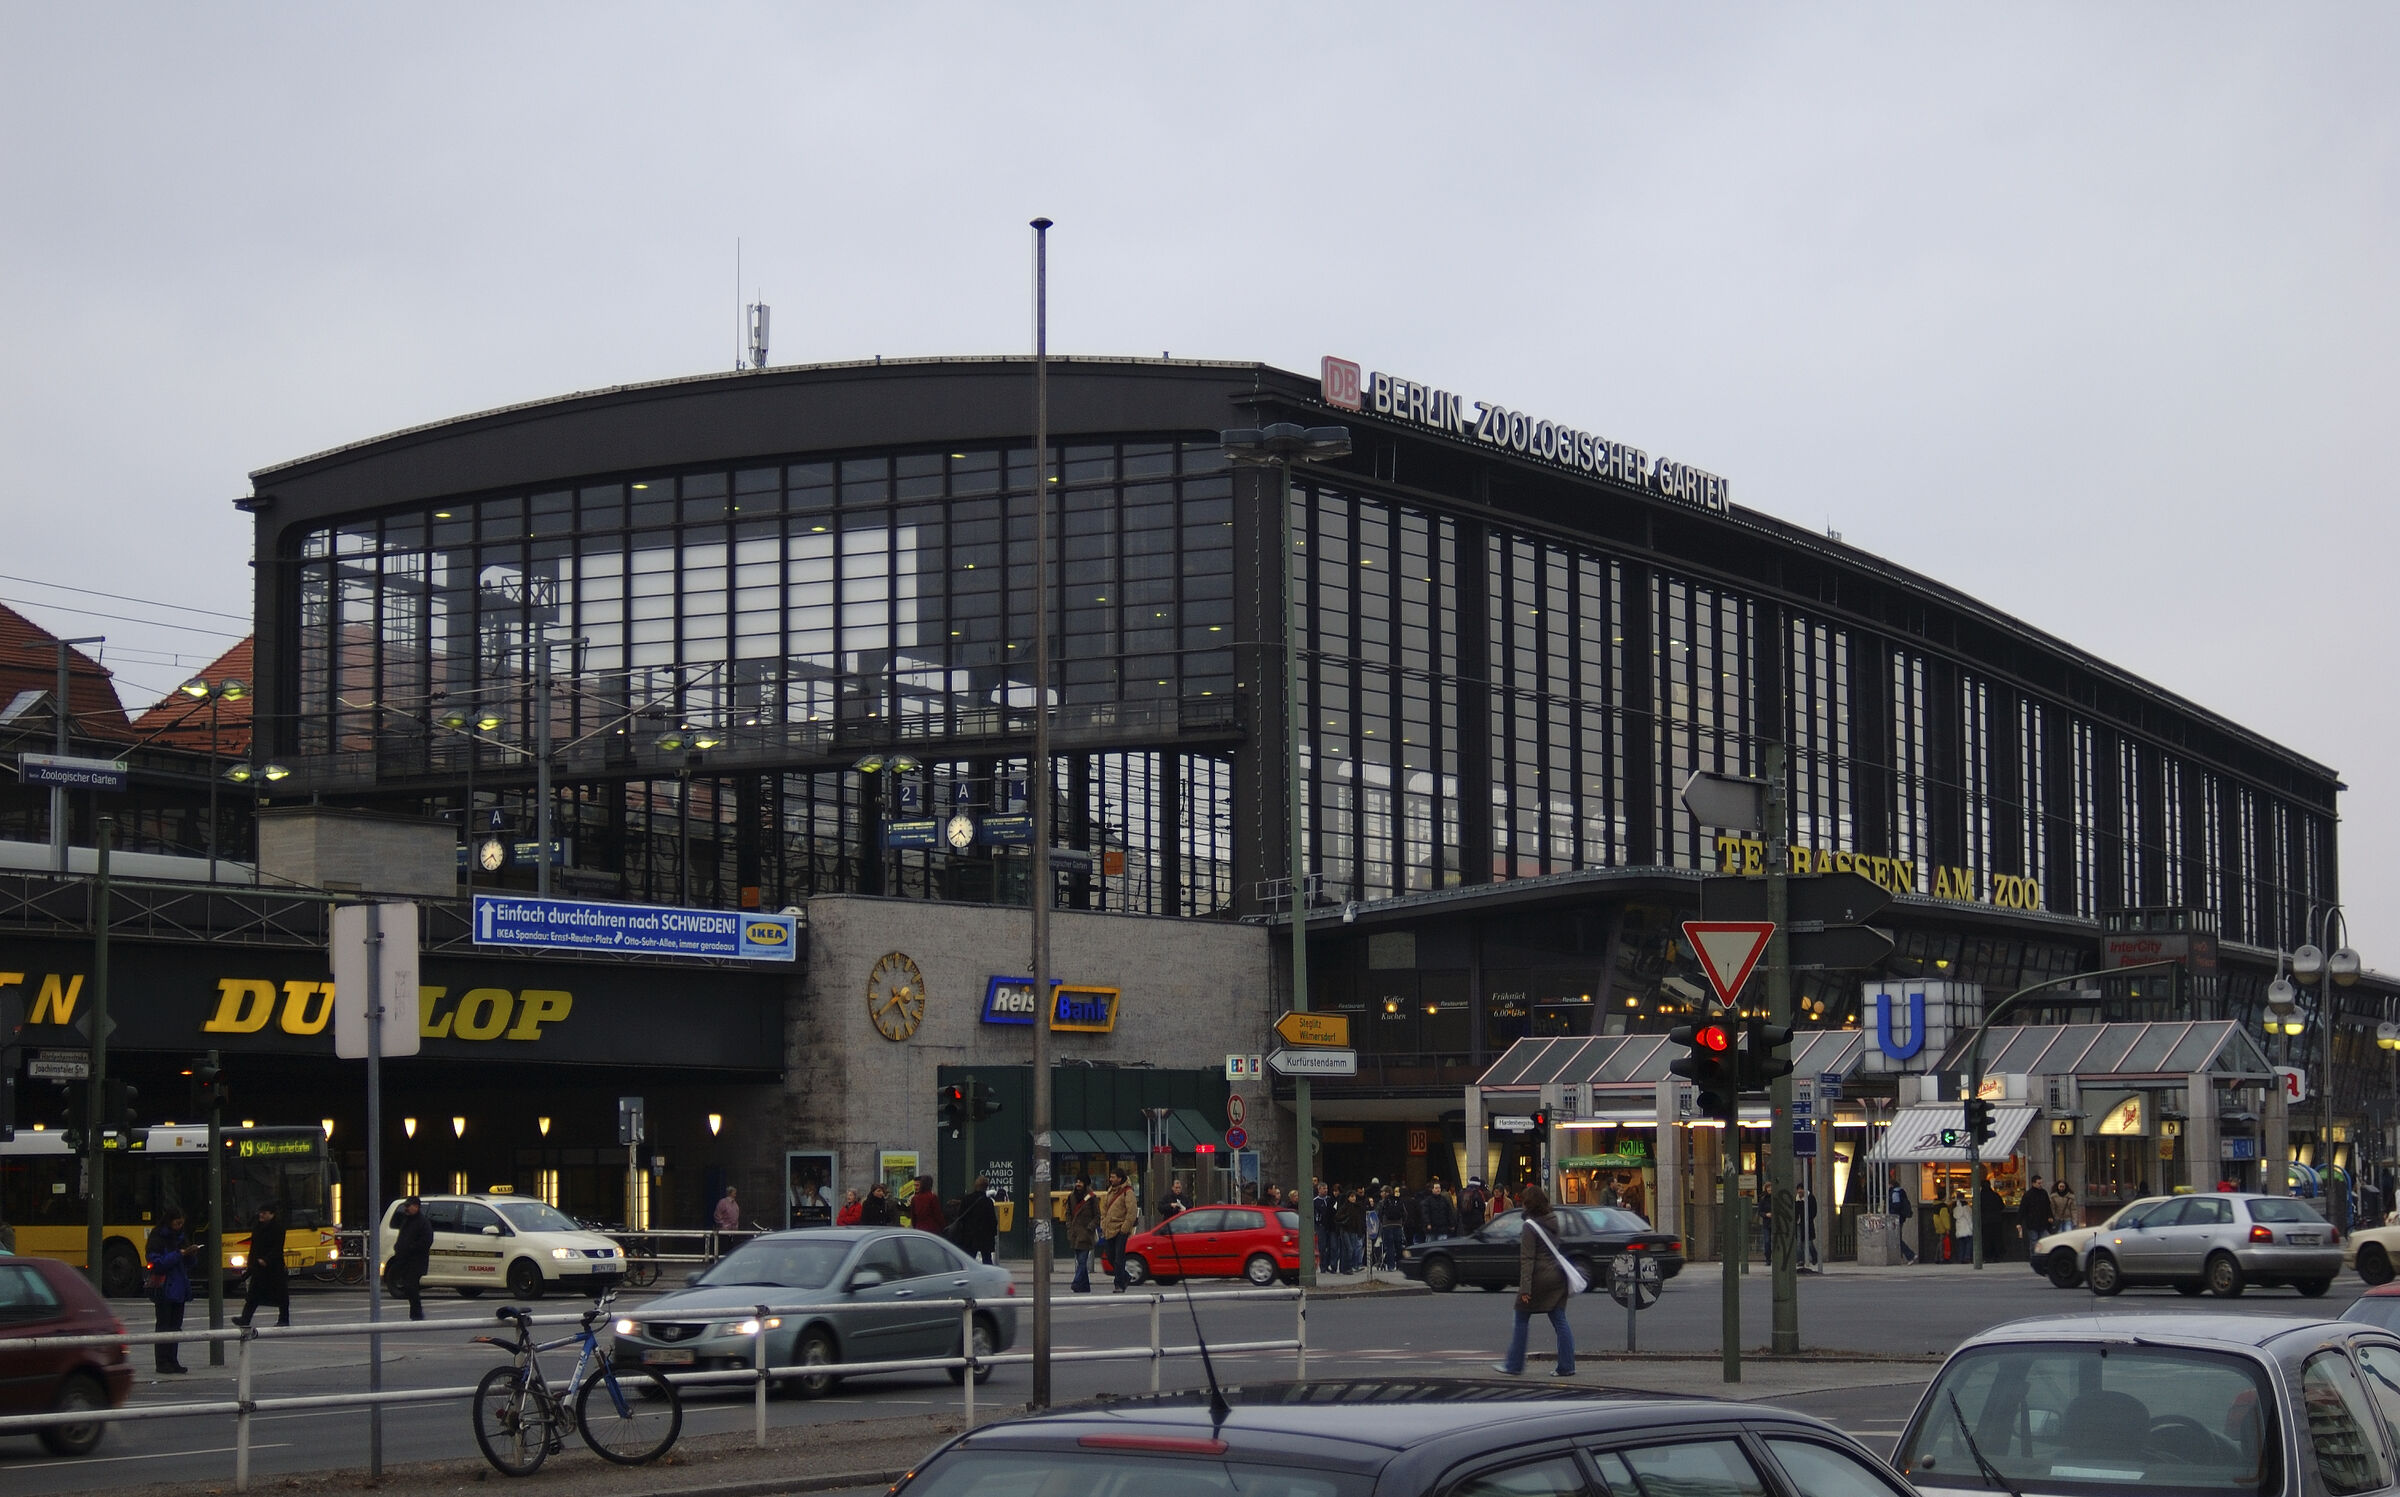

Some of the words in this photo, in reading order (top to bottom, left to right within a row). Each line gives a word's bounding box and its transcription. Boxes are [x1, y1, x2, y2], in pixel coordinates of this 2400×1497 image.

[1329, 364, 1358, 401] DB
[1370, 371, 1462, 434] BERLIN
[1474, 400, 1649, 488] ZOOLOGISCHER
[1654, 456, 1729, 513] GARTEN
[40, 768, 90, 783] Zoologischer
[91, 773, 117, 785] Garten
[902, 786, 911, 801] 2
[958, 783, 969, 799] A
[1020, 781, 1027, 796] 1
[492, 810, 501, 824] A
[1716, 835, 1915, 895] TERASSEN
[1934, 864, 1976, 902] AM
[1991, 873, 2041, 911] ZOO
[496, 903, 545, 923] Einfach
[548, 906, 626, 928] durchfahren
[629, 913, 659, 930] nach
[661, 913, 736, 935] SCHWEDEN!
[497, 929, 514, 939] IKEA
[515, 929, 550, 941] Spandau:
[551, 931, 613, 945] Ernst-Reuter-Platz
[679, 939, 700, 949] immer
[700, 941, 735, 952] geradeaus
[751, 927, 783, 939] IKEA
[0, 971, 84, 1025] N
[1492, 992, 1526, 1000] Frühstück
[203, 977, 573, 1041] DULOP
[1058, 995, 1107, 1021] Bank
[1299, 1018, 1321, 1030] Steglitz
[1876, 993, 1925, 1060] U
[1299, 1030, 1336, 1042] Wilmersdorf
[1286, 1056, 1347, 1068] Kurfürstendamm
[240, 1140, 253, 1157] X9
[1412, 1132, 1426, 1150] DB
[979, 1169, 1014, 1177] CAMBIO
[989, 1160, 1014, 1169] BANK
